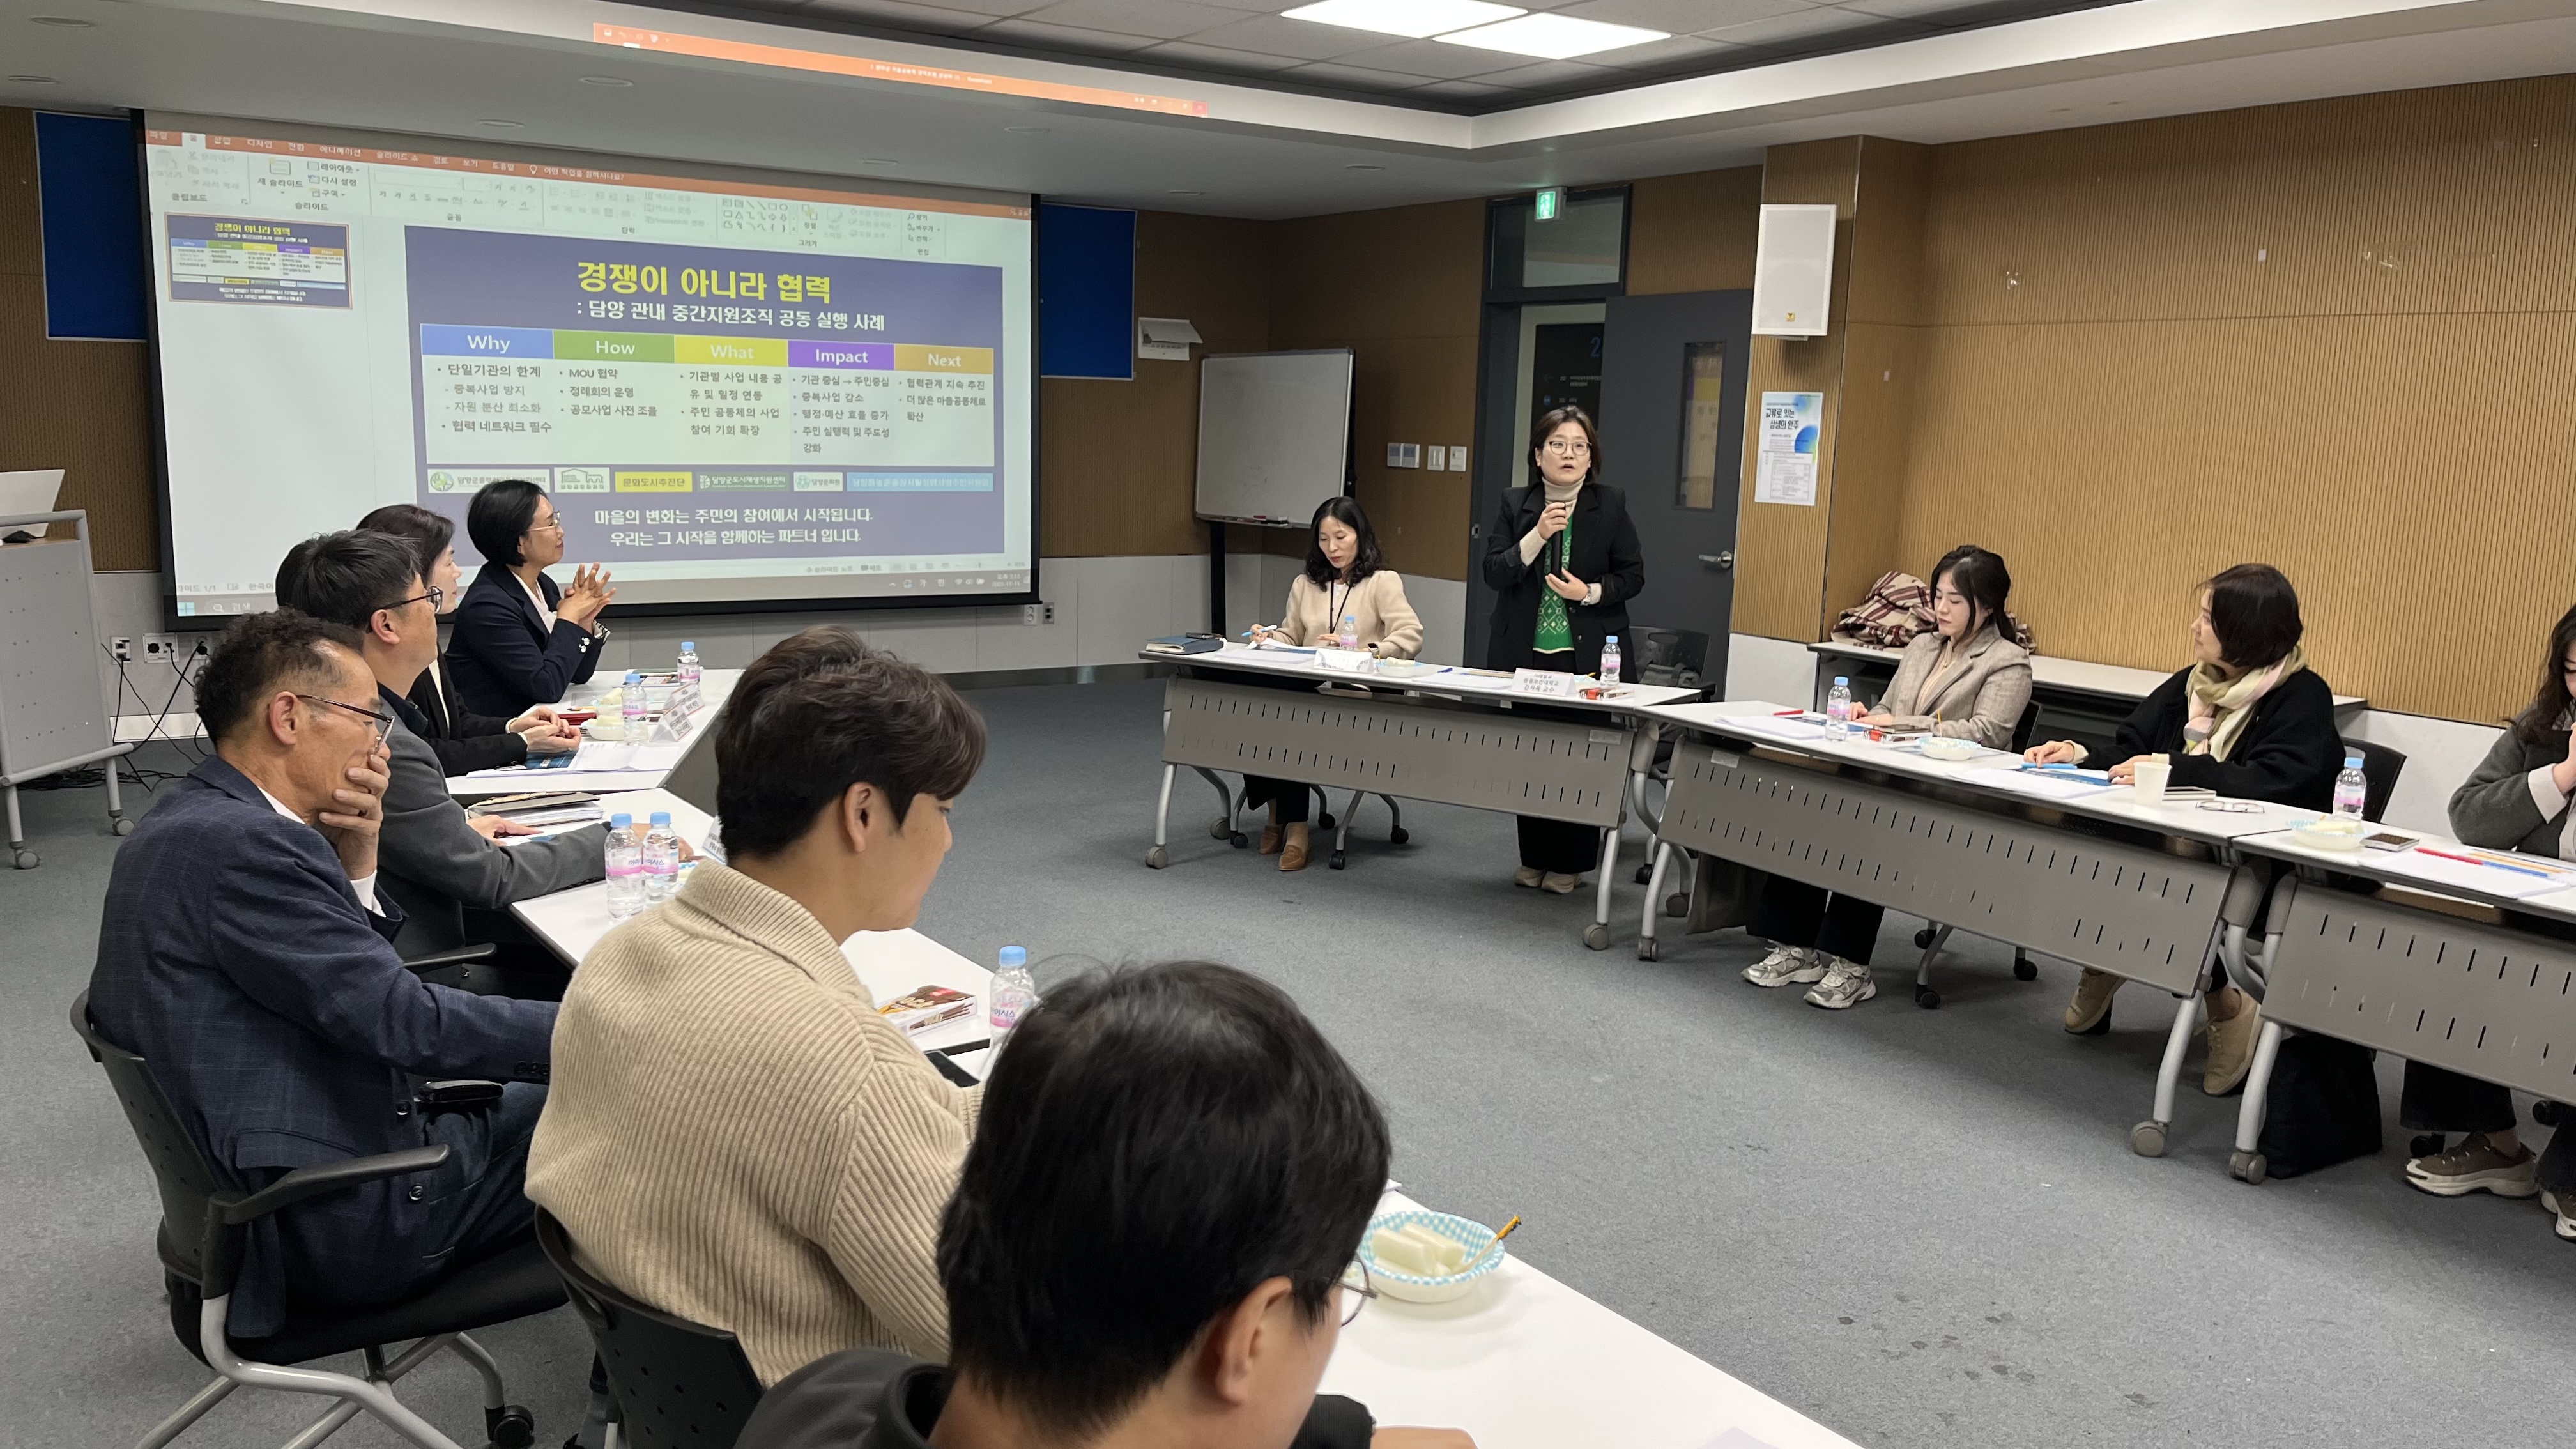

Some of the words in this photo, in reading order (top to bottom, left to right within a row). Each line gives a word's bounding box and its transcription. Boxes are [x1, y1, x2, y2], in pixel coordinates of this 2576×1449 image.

[150, 132, 167, 140] 파일
[247, 139, 272, 148] 디자인
[289, 142, 304, 151] 전환
[320, 146, 360, 157] 애니메이션
[377, 151, 408, 160] 슬라이드
[492, 162, 514, 172] 도움말
[321, 164, 353, 174] 레이아웃
[270, 180, 303, 188] 슬라이드
[322, 176, 338, 185] 다시
[322, 190, 338, 198] 구역
[295, 202, 328, 211] 슬라이드
[799, 240, 817, 248] 그리기
[578, 261, 668, 296] 경쟁이
[680, 267, 767, 301] 아니라
[777, 273, 830, 304] 협력
[588, 300, 624, 320] 담양
[631, 302, 666, 321] 관내
[672, 304, 773, 326] 중간지원조직
[779, 309, 811, 328] 공동
[816, 311, 848, 330] 실행
[854, 313, 885, 332] 사례
[467, 335, 510, 354] Why
[595, 340, 636, 355] How
[1590, 336, 1600, 358] 2
[710, 344, 755, 359] What
[816, 348, 868, 365] Impact
[928, 353, 962, 367] Next
[448, 364, 511, 377] 단일기관의
[516, 365, 541, 378] 한계
[569, 369, 594, 378] MOU
[597, 368, 618, 379] 협약
[689, 371, 720, 383] 기관별
[724, 372, 744, 383] 사업
[749, 373, 769, 384] 내용
[772, 374, 783, 384] 공
[801, 375, 819, 385] 기관
[822, 376, 840, 386] 중심
[854, 376, 889, 387] 주민중심
[454, 383, 498, 395] 중복사업
[503, 385, 525, 395] 방지
[907, 378, 942, 390] 협력관계
[946, 379, 964, 390] 지속
[968, 380, 985, 391] 추진
[570, 385, 611, 397] 정례회의
[614, 387, 634, 398] 운영
[689, 389, 700, 400] 유
[704, 389, 714, 400] 및
[718, 390, 738, 401] 일정
[742, 390, 762, 401] 연동
[802, 392, 841, 402] 중복사업
[845, 393, 864, 403] 감소
[907, 395, 915, 405] 더
[917, 395, 934, 406] 많은
[454, 401, 477, 413] 자원
[482, 402, 503, 413] 분산
[508, 402, 541, 413] 최소화
[571, 404, 611, 415] 공모사업
[615, 405, 634, 416] 사전
[638, 406, 657, 417] 조율
[690, 407, 710, 417] 주민
[715, 407, 756, 418] 공동체의
[760, 408, 779, 418] 사업
[848, 410, 866, 420] 효율
[870, 411, 889, 421] 증가
[907, 411, 924, 422] 확산
[452, 420, 475, 432] 협력
[479, 420, 526, 433] 네트워크
[529, 421, 552, 433] 필수
[691, 424, 710, 435] 참여
[716, 425, 735, 435] 기회
[740, 425, 760, 436] 확장
[802, 426, 820, 437] 주민
[824, 427, 850, 437] 실행력
[853, 427, 862, 437] 및
[864, 427, 889, 438] 주도성
[803, 443, 822, 454] 강화
[623, 478, 685, 487] 문화도시추진단
[595, 510, 640, 525] 마을의
[645, 509, 689, 524] 변화는
[694, 509, 737, 523] 주민의
[743, 508, 799, 523] 참여에서
[804, 507, 873, 523] 시작됩니다.
[610, 532, 654, 546] 우리는
[657, 532, 672, 545] 그
[676, 530, 717, 545] 시작을
[721, 529, 775, 544] 함께하는
[778, 529, 817, 543] 파트너
[821, 528, 861, 543] 입니다.
